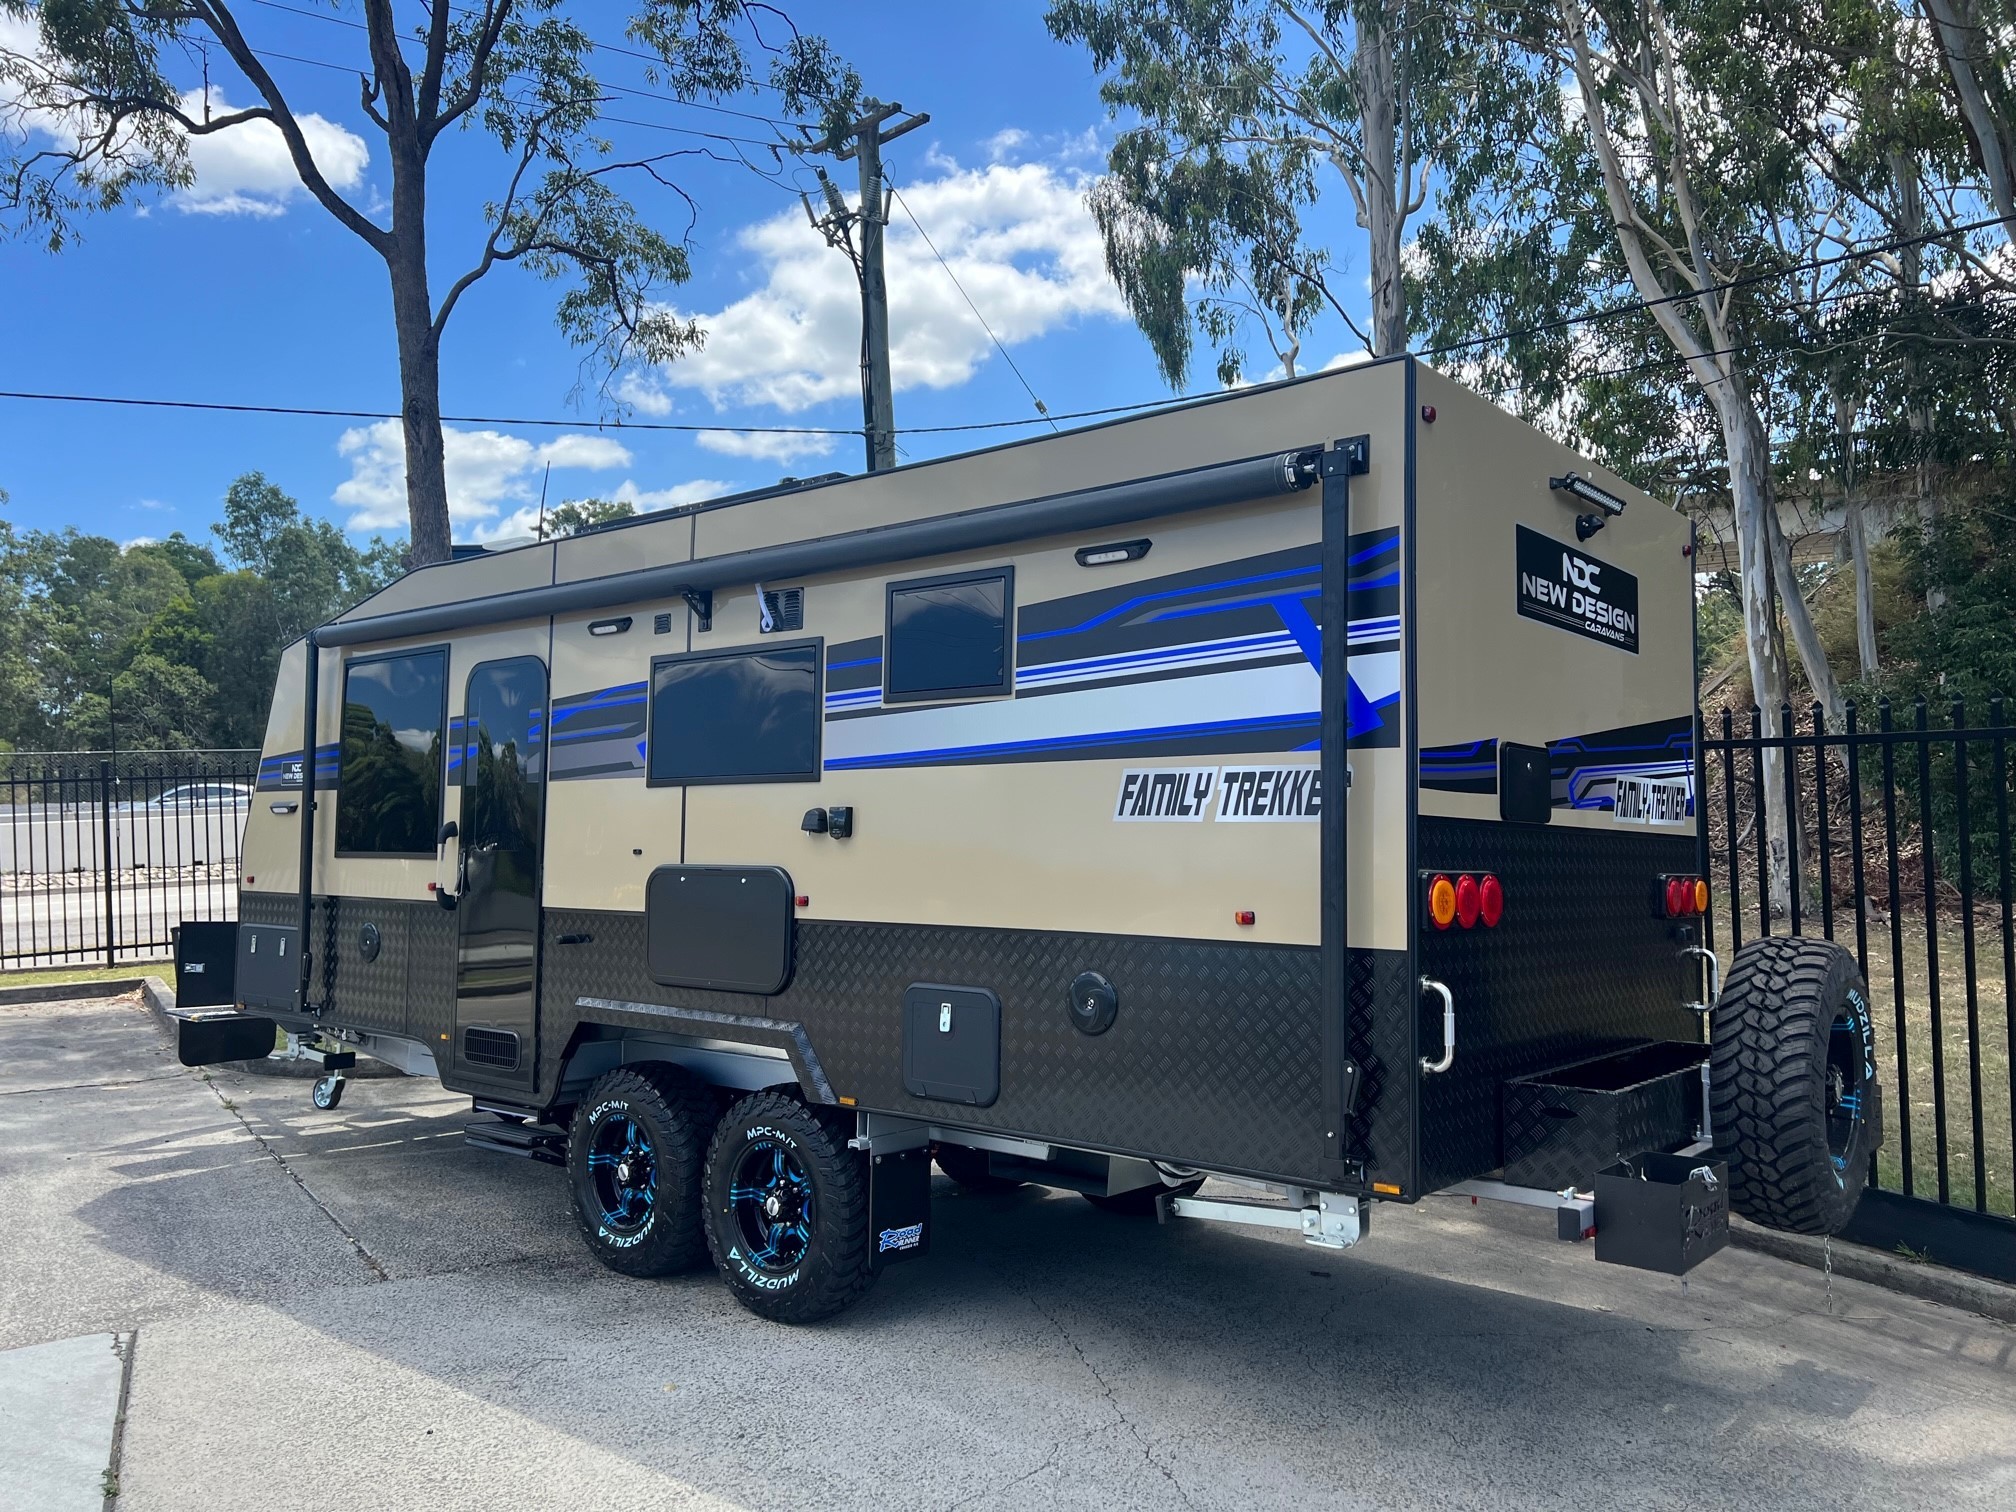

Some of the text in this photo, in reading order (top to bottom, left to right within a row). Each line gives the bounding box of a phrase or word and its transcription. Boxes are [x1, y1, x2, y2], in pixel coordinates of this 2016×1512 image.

[1562, 552, 1601, 595] NDC
[1522, 571, 1635, 635] NEW DESIGN
[1584, 621, 1625, 642] CARAVANS
[1118, 769, 1352, 816] FAMILY TREKKE
[1615, 780, 1686, 821] FAMILY TREKKER
[1847, 988, 1873, 1081] MUDZILLA
[598, 1212, 655, 1248] MUDZILLA
[729, 1246, 800, 1290] MUDZILLA
